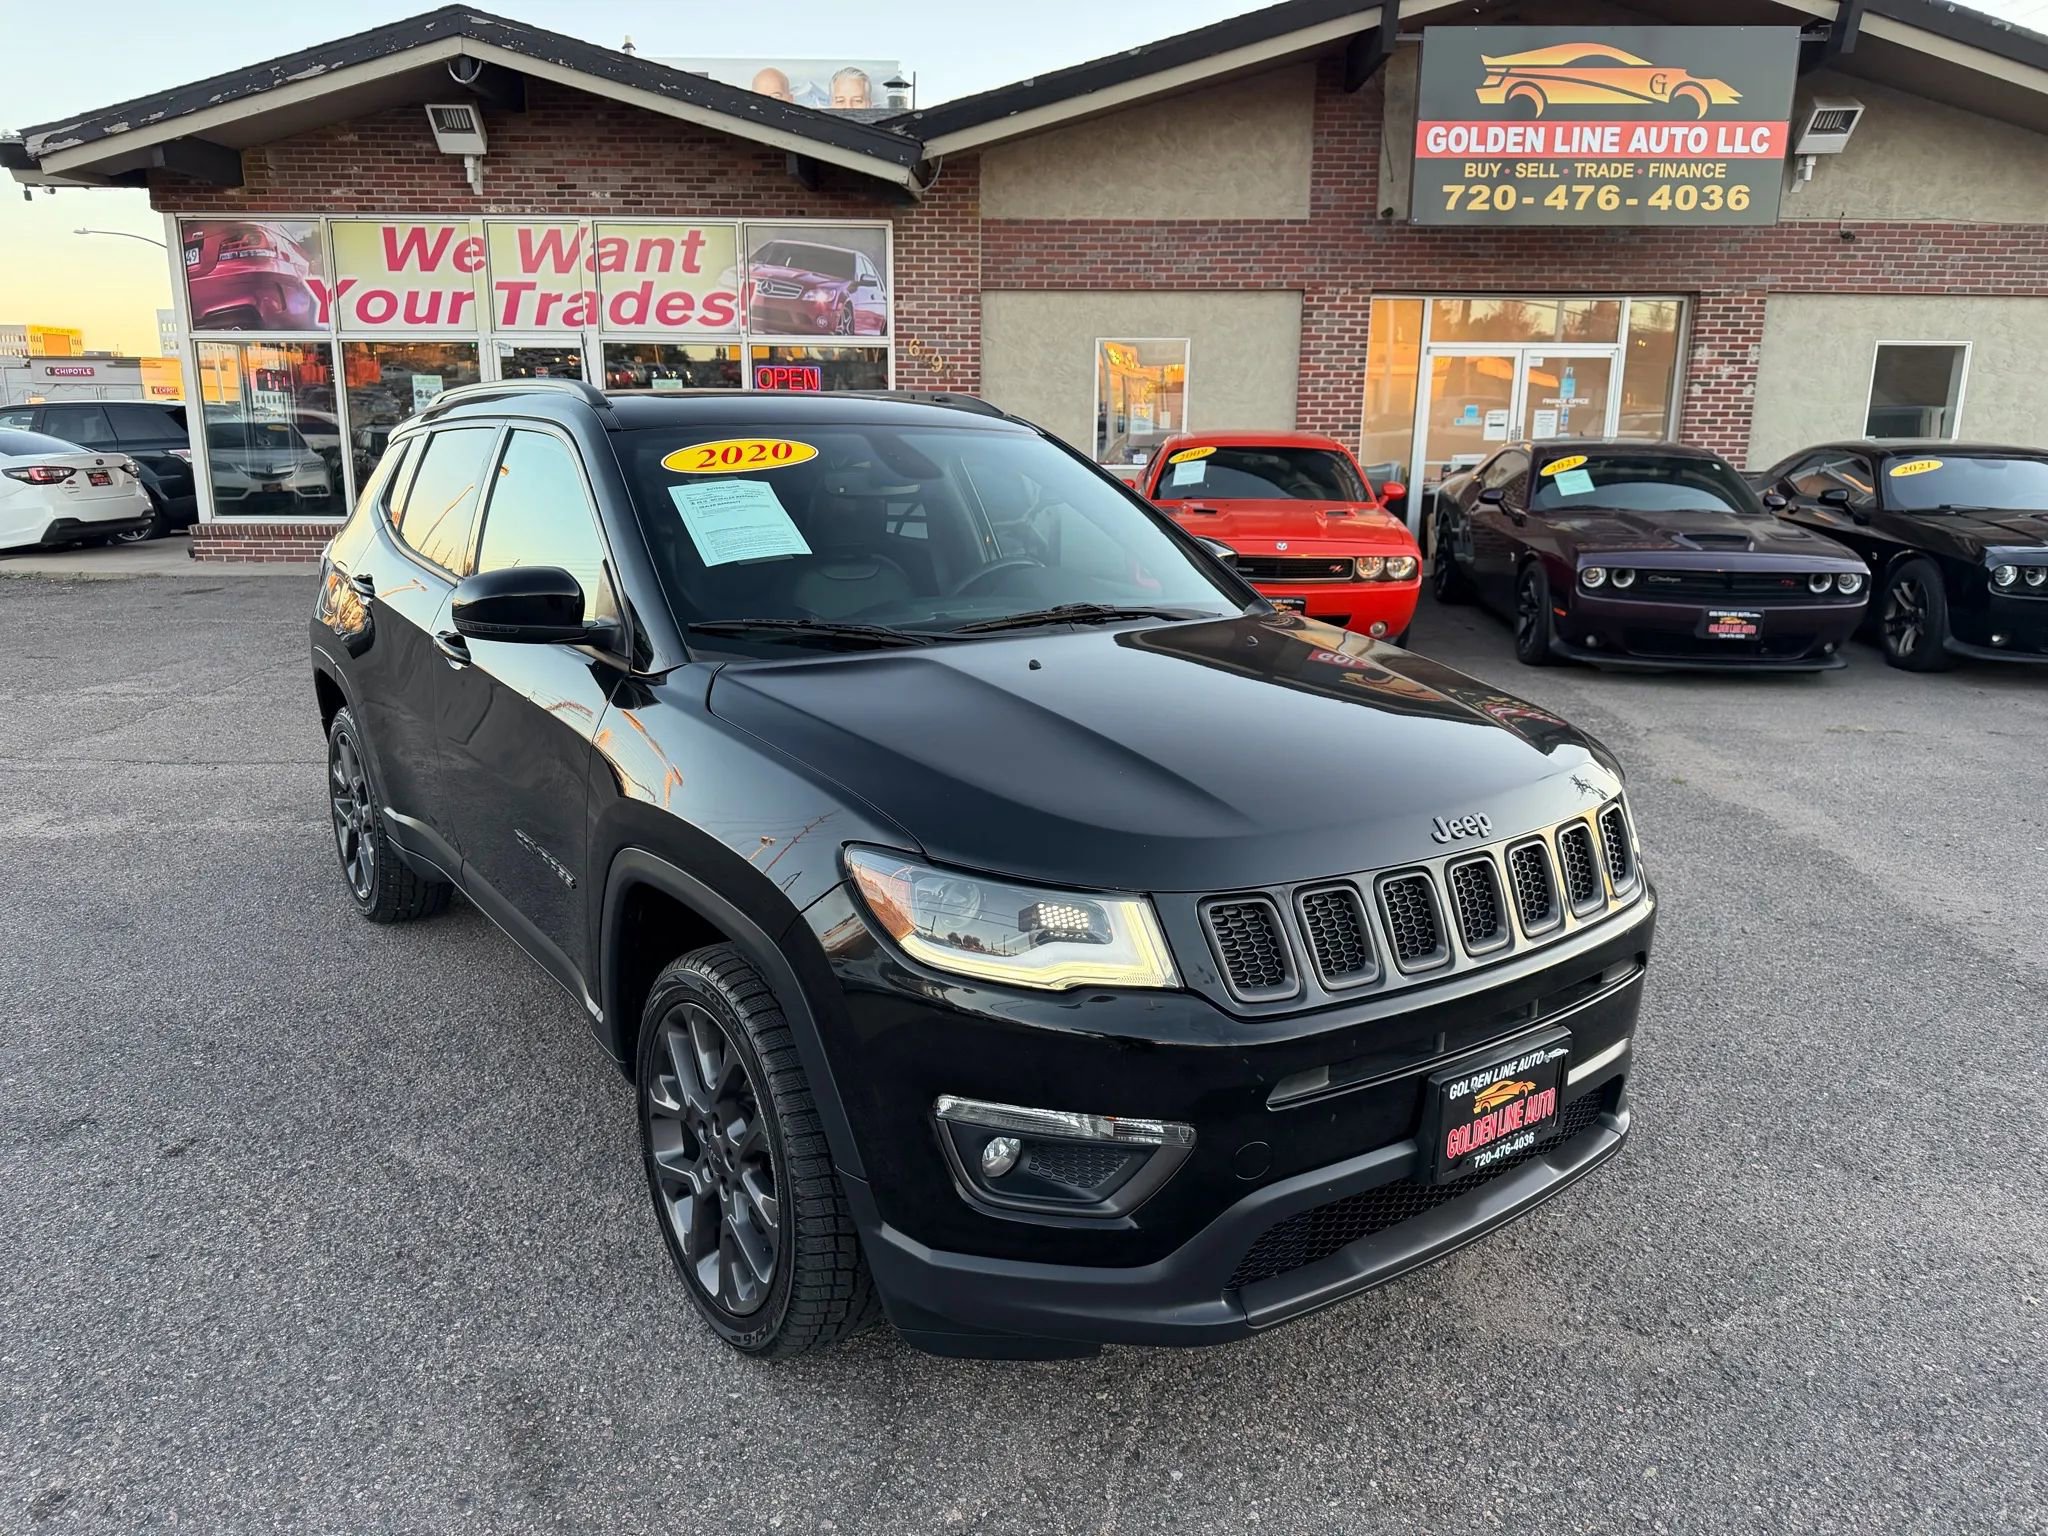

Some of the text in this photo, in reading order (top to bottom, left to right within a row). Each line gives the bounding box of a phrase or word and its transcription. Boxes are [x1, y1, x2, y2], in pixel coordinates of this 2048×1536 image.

[1426, 126, 1771, 154] GOLDEN LINE AUTO LLC
[1464, 162, 1727, 178] BUY SELL TRADE FINANCE
[382, 226, 707, 274] We Want
[305, 279, 756, 328] Your Trades!
[757, 367, 818, 390] OPEN
[696, 442, 793, 469] 2020
[1179, 447, 1209, 460] 2009
[1550, 457, 1578, 473] 2021
[1901, 462, 1931, 474] 2021
[1431, 811, 1493, 844] Jeep
[1449, 1050, 1545, 1100] GOLDEN LINE AUTO
[1446, 1086, 1557, 1160] GOLDEN LINE AUTO
[1474, 1131, 1536, 1169] 720-476-4036
